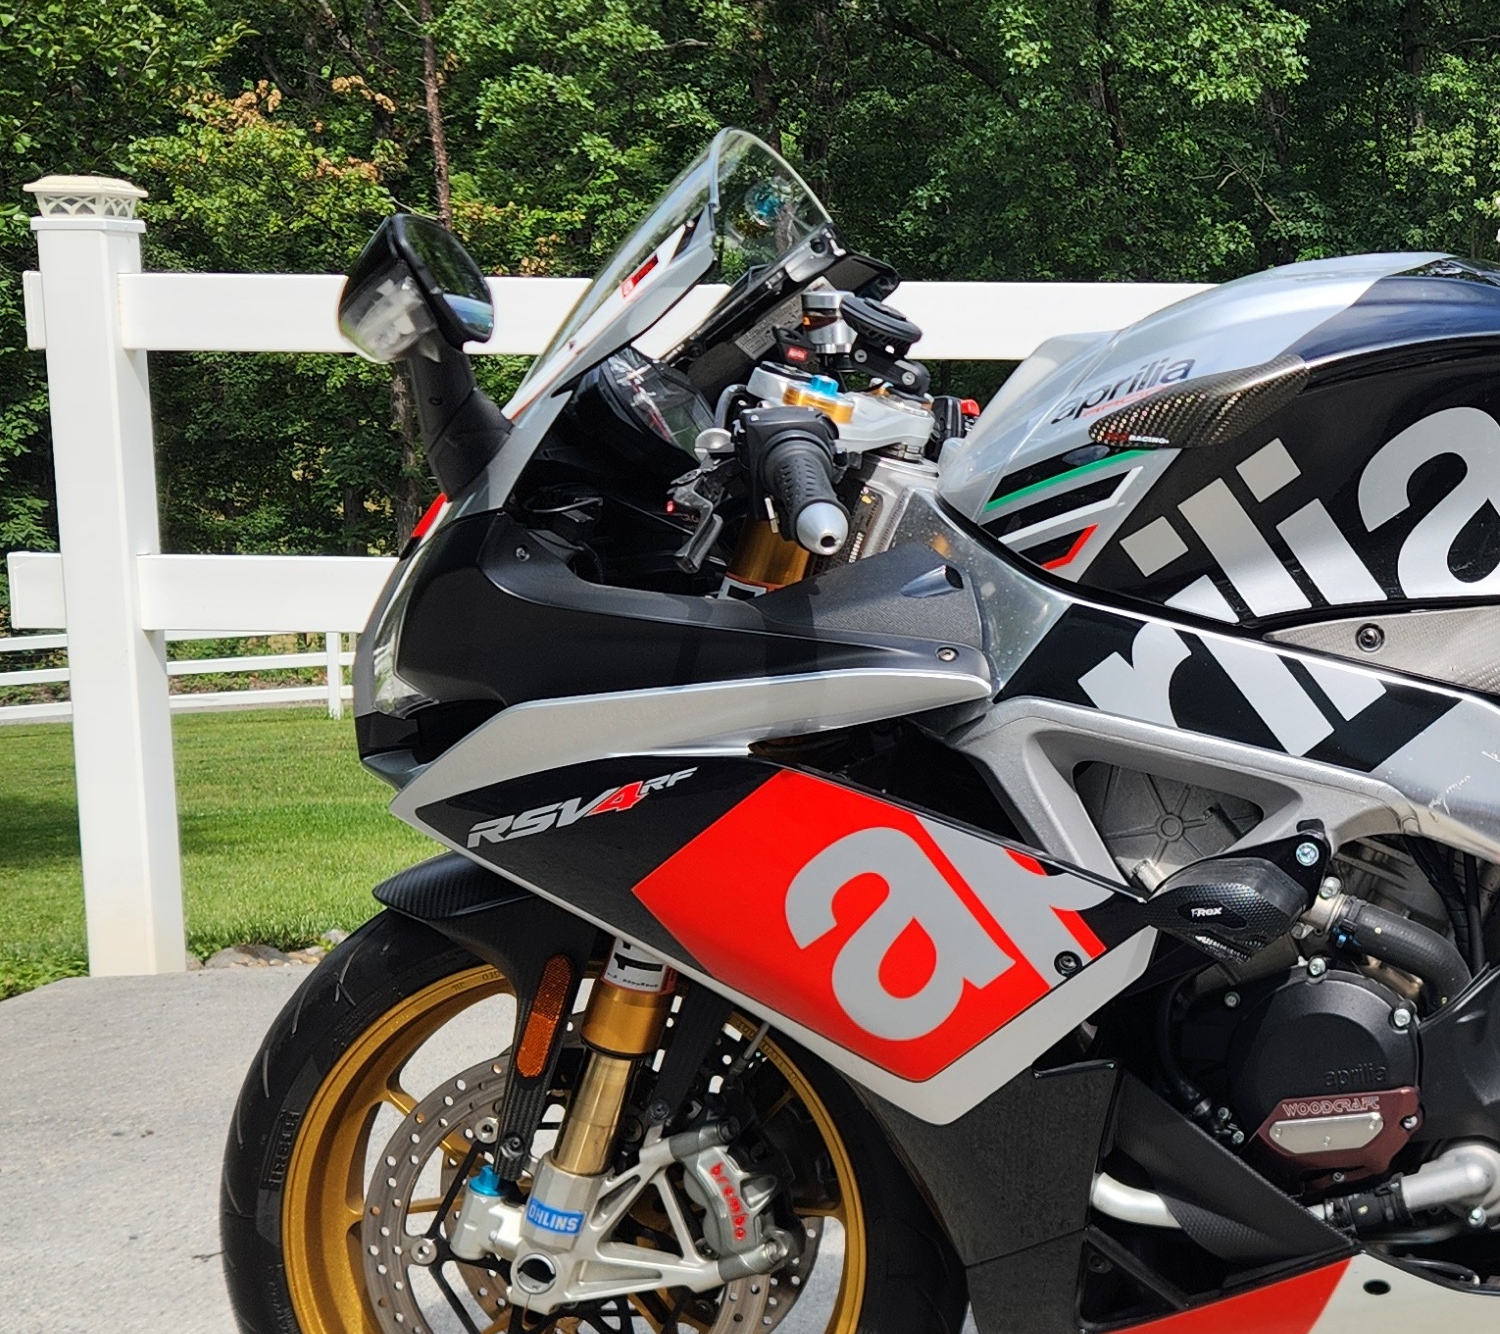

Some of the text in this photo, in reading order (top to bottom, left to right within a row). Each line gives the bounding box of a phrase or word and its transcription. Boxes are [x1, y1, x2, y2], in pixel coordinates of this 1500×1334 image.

[1050, 357, 1196, 425] aprilia
[1323, 1062, 1387, 1089] aprilia
[710, 1162, 749, 1241] brembo
